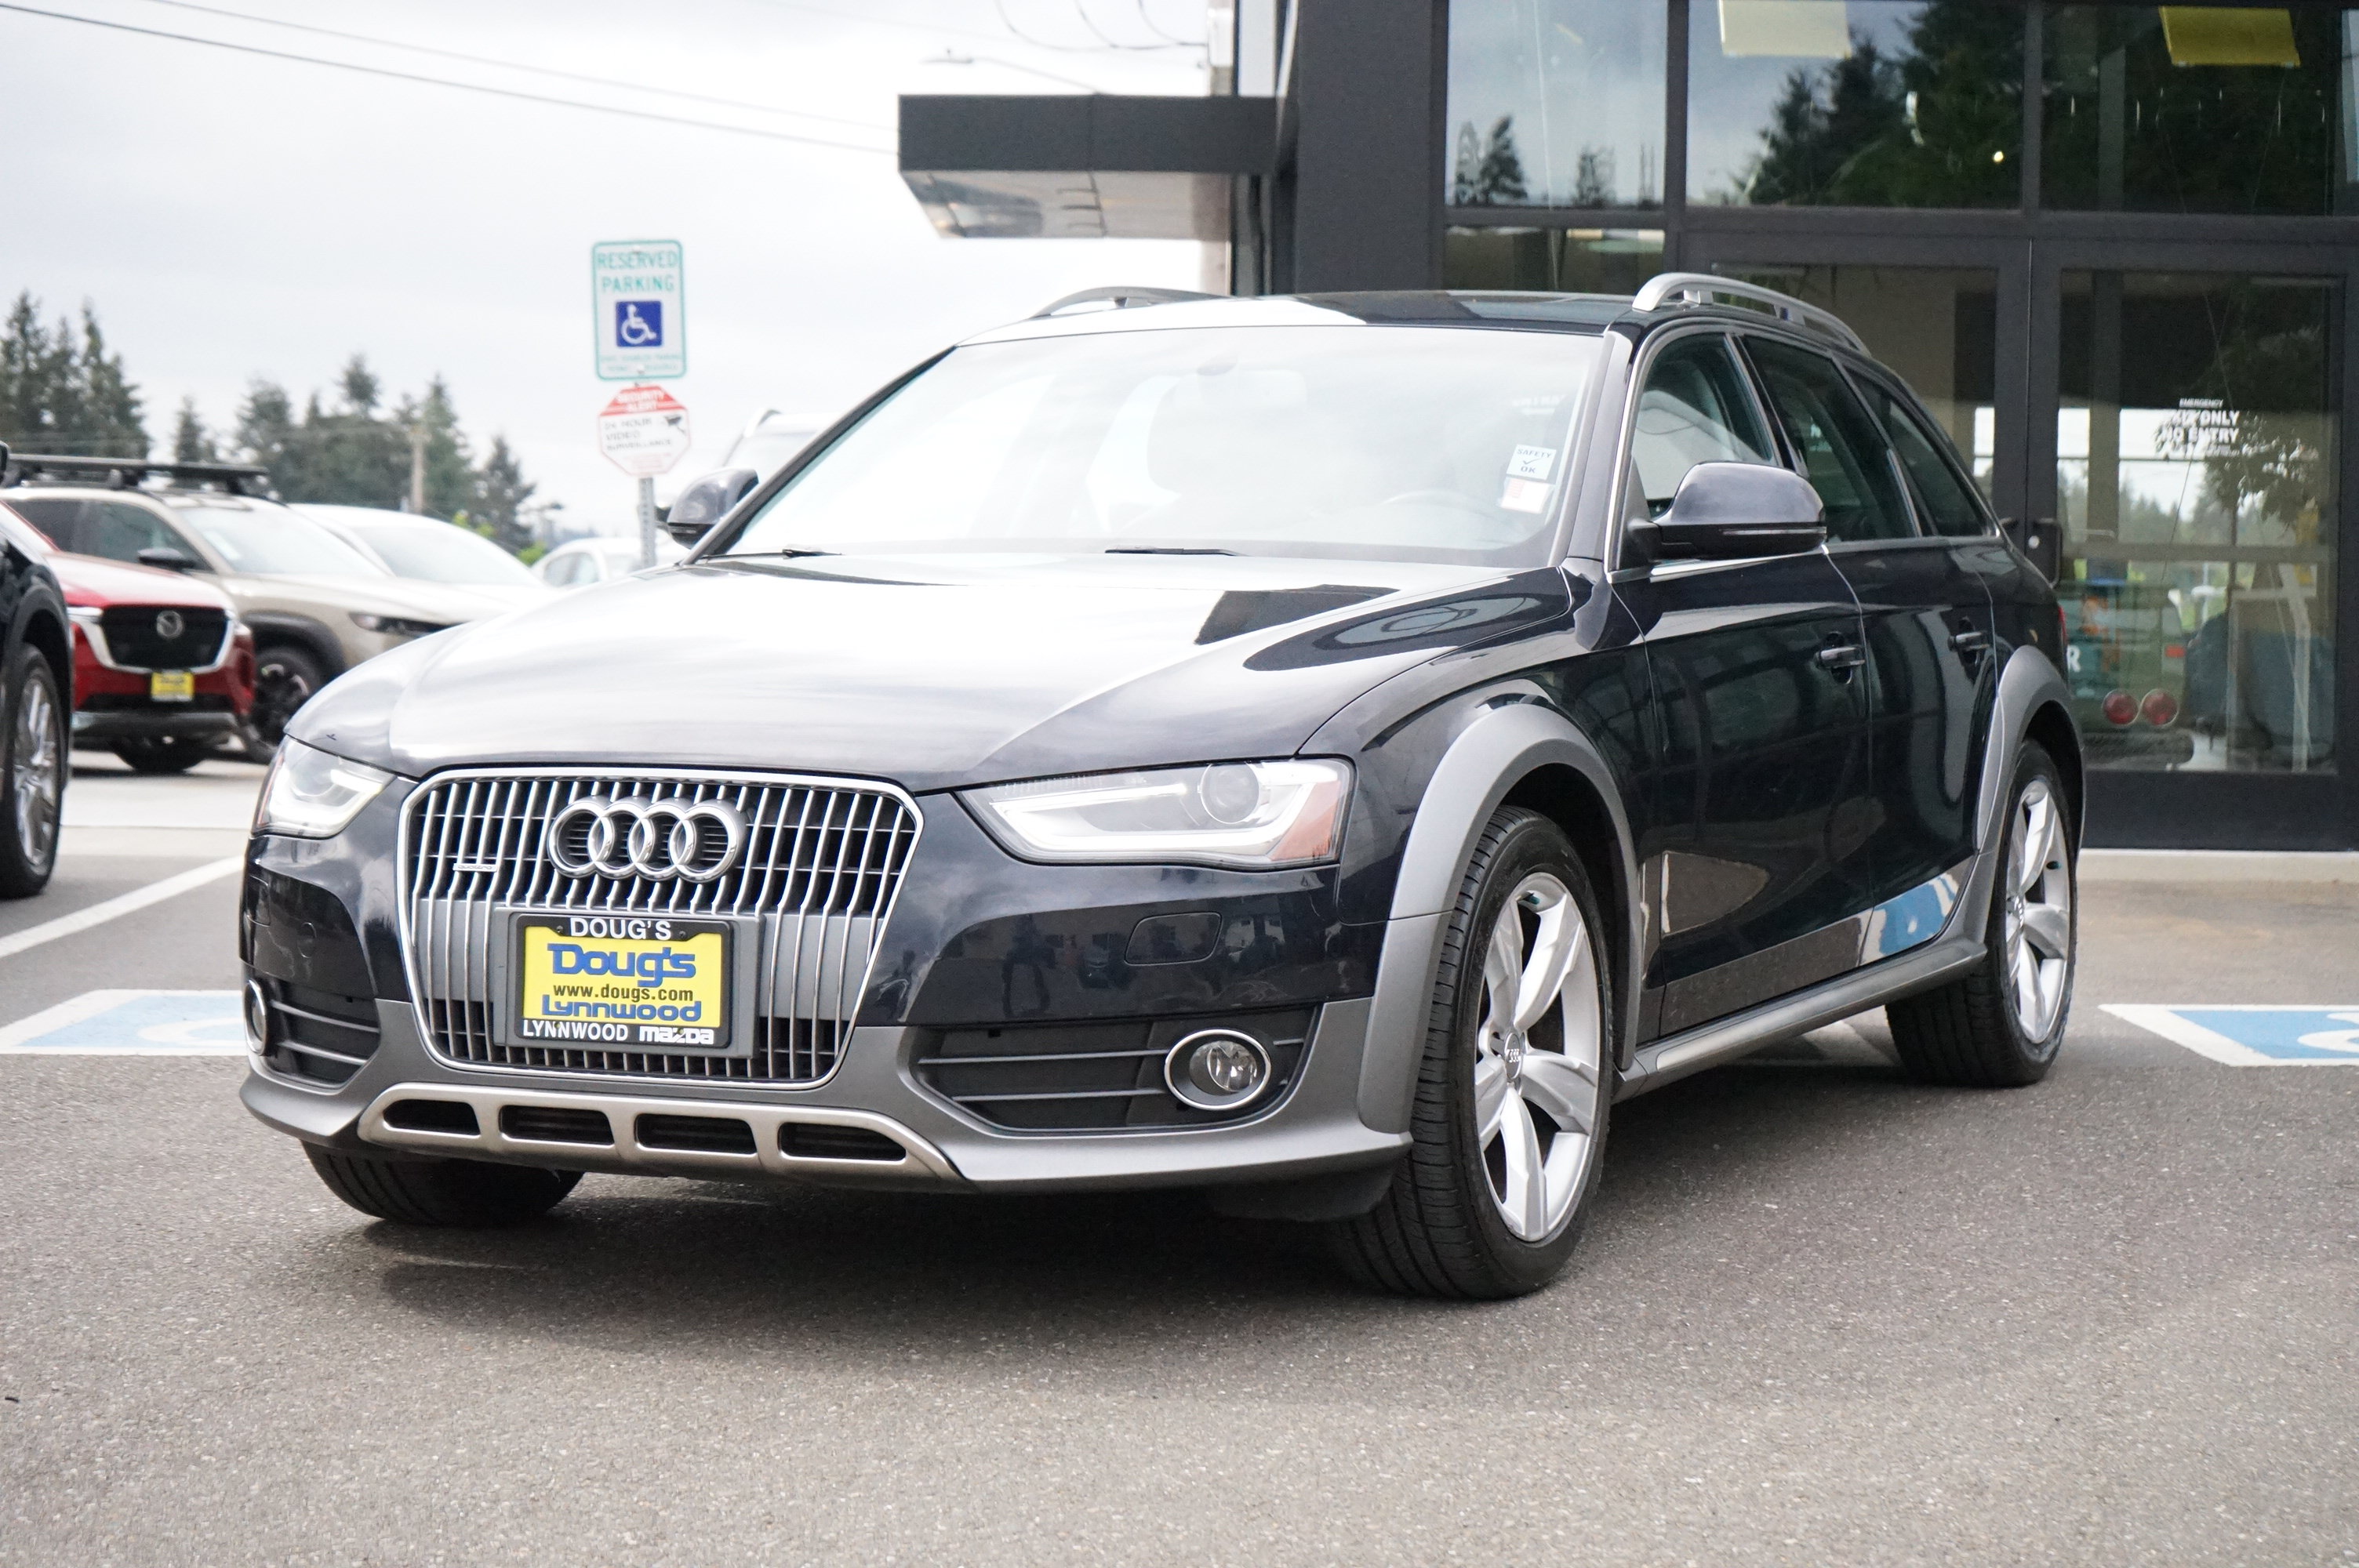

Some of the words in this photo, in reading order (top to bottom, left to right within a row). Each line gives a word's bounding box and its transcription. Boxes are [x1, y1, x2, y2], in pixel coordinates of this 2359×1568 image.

[597, 249, 678, 269] RESERVED
[602, 274, 674, 292] PARKING
[2179, 397, 2224, 408] EMERGENCY
[2199, 410, 2240, 426] ONLY
[2188, 427, 2239, 444] ENTRY
[1517, 448, 1552, 459] SAFETY
[570, 917, 671, 940] DOUG'S
[547, 943, 696, 988] Doug's
[553, 984, 693, 1002] www.dougs.com
[542, 994, 702, 1022] Lynnwood
[523, 1019, 628, 1041] LYNNWOOD
